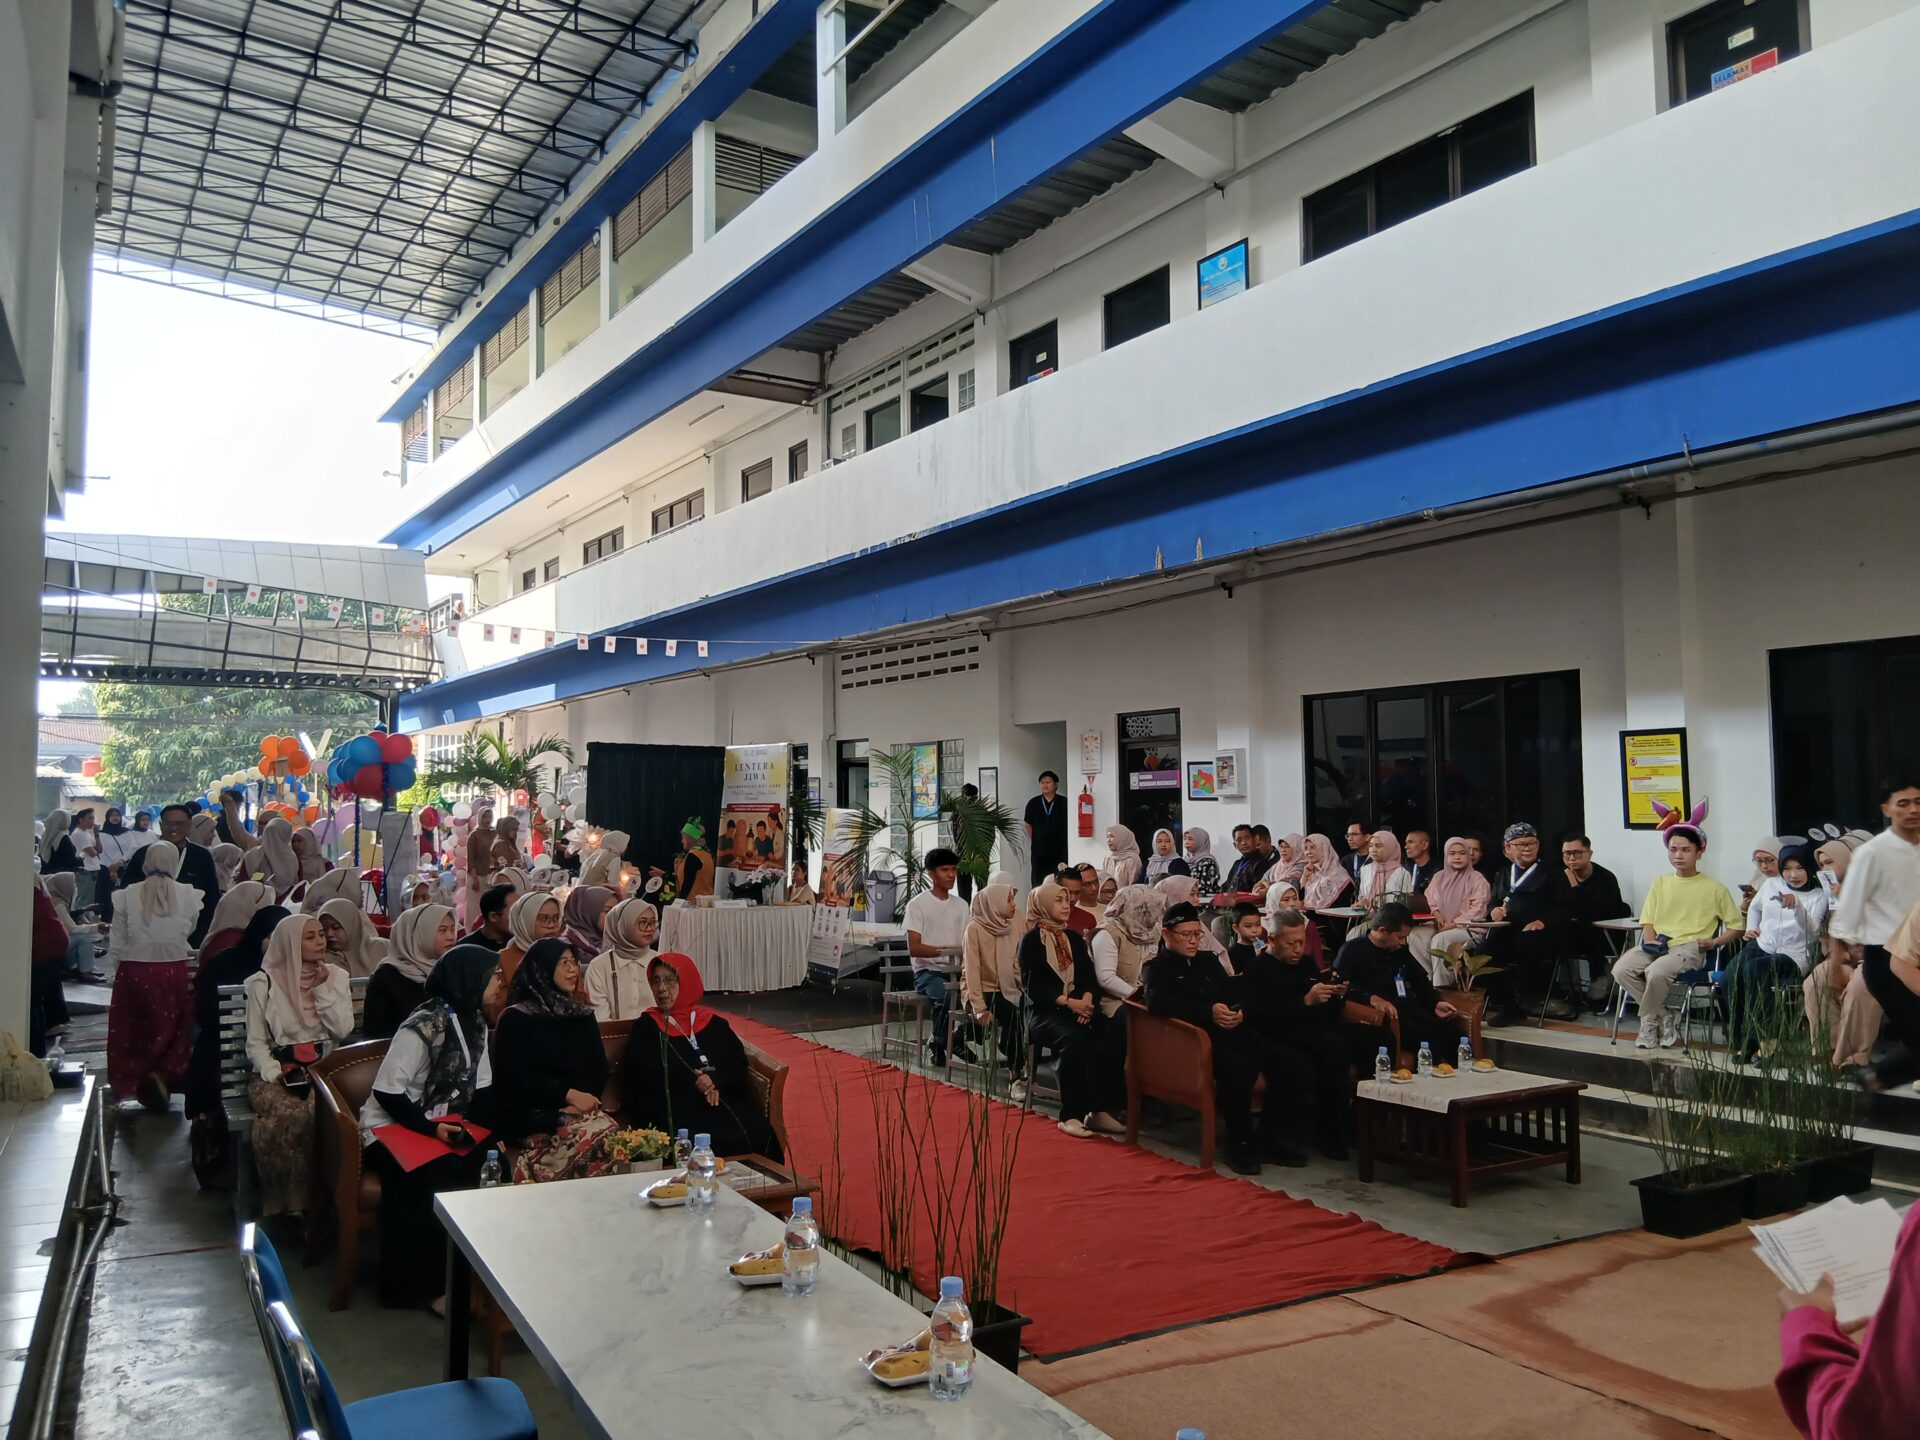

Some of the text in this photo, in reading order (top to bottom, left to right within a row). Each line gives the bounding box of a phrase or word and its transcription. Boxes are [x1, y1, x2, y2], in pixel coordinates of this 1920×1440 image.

[1713, 64, 1750, 85] SELAMAT
[734, 762, 775, 772] LENTERA
[743, 773, 766, 781] JIWA
